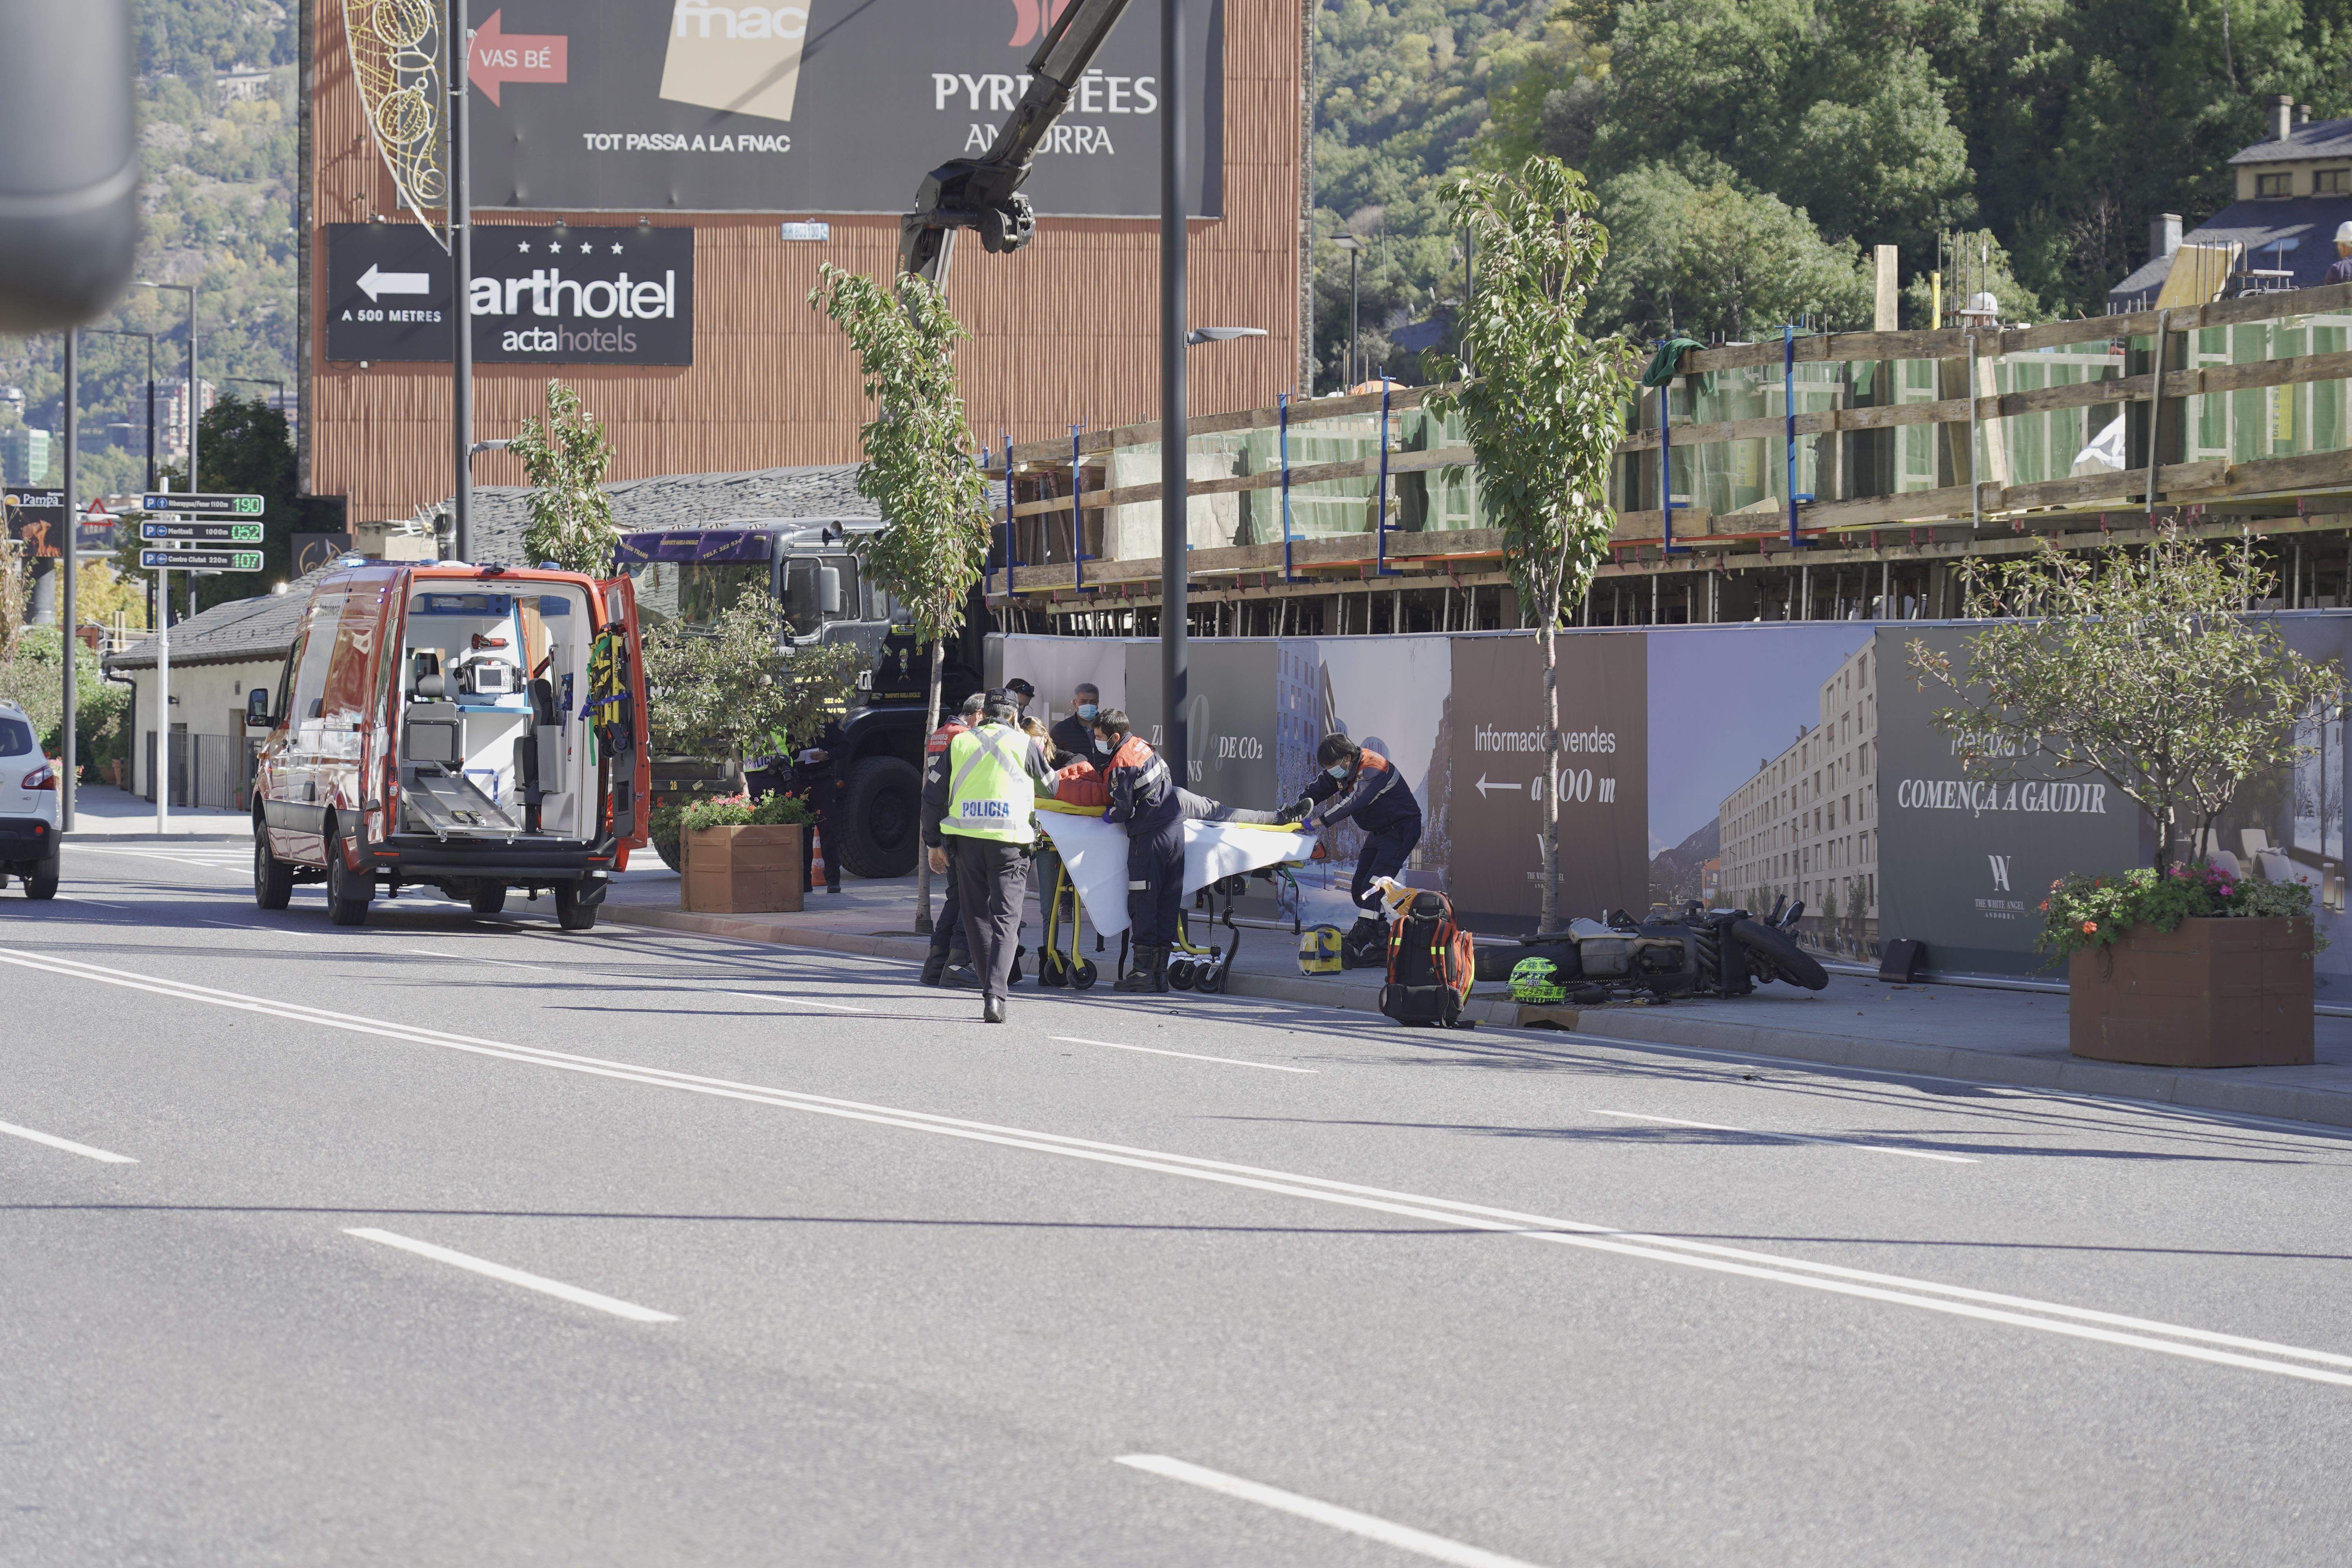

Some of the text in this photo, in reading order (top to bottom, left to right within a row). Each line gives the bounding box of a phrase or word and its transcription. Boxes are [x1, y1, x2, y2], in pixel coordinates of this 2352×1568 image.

[673, 0, 808, 39] fnac
[480, 46, 552, 68] VAS BÉ
[583, 133, 791, 152] TOT PASSA A LA FNAC
[470, 268, 675, 319] arthotel
[341, 310, 442, 323] A 500 METRES
[502, 324, 637, 352] actahotels
[23, 493, 58, 508] Pampa
[233, 498, 260, 513] 190
[231, 525, 260, 540] 052
[719, 544, 730, 553] 322
[731, 538, 742, 547] 534
[232, 553, 260, 568] 107
[633, 548, 649, 560] TRANS
[916, 646, 923, 656] 28
[1562, 725, 1615, 753] vendes
[1218, 737, 1237, 758] DE
[670, 780, 677, 790] 28
[1599, 777, 1615, 803] m
[1898, 778, 2107, 818] COMENÇA A GAUDIR
[963, 802, 1010, 817] POLICIA
[1975, 899, 2025, 910] THE WHITE ANGEL
[1519, 986, 1544, 996] 46
